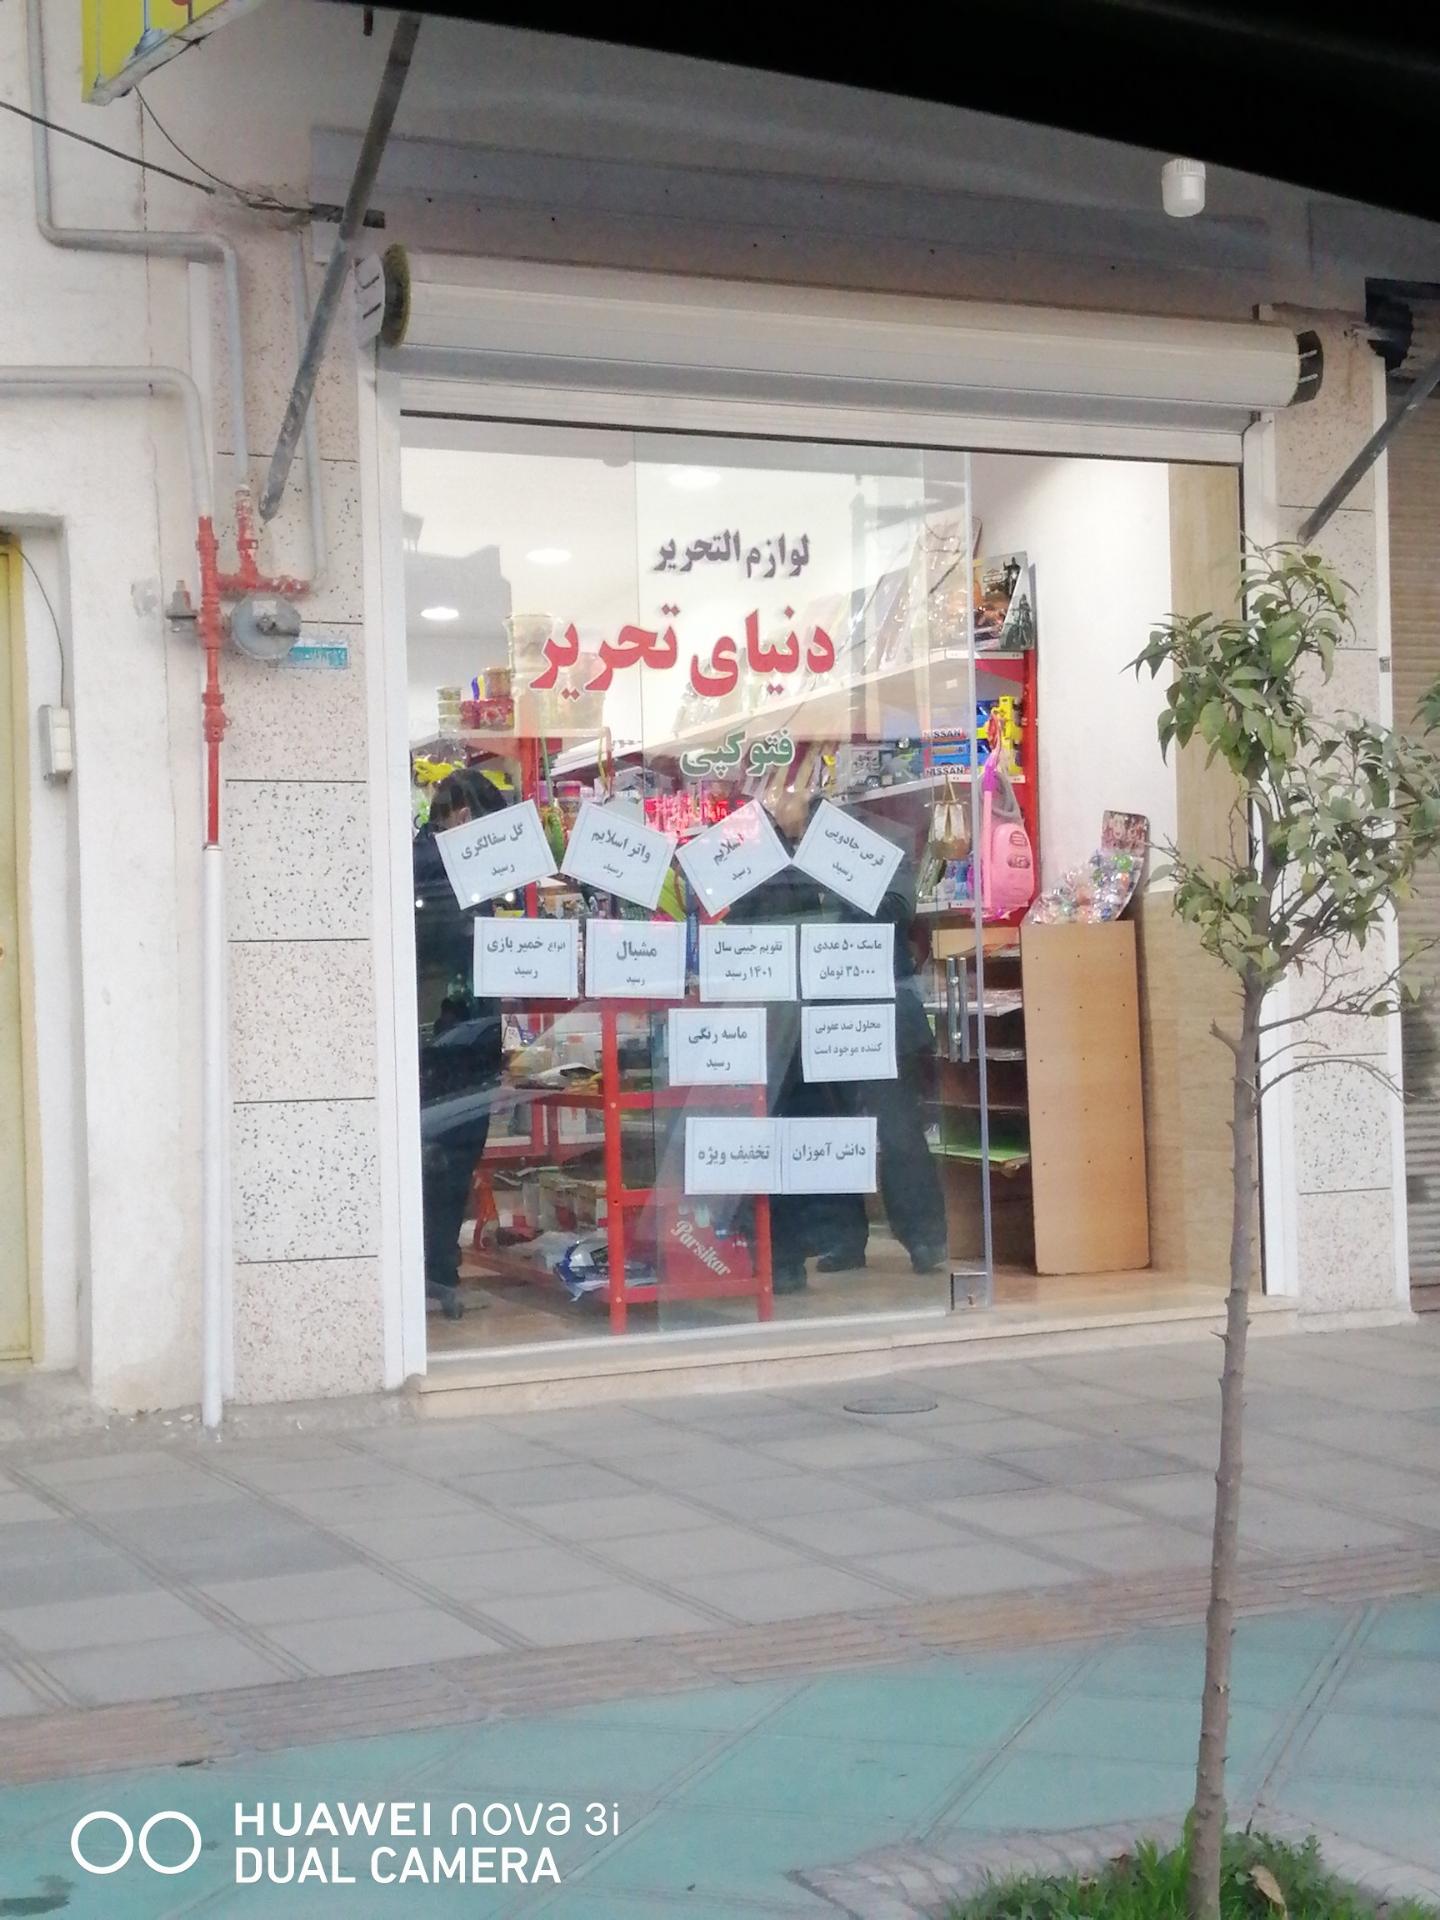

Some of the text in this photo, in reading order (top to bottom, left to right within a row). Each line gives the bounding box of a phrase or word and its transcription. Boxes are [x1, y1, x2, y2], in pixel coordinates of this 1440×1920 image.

[655, 529, 810, 578] لوازم التحریر
[529, 602, 836, 702] دنیای تحریر
[926, 765, 964, 777] NISSAN
[491, 863, 515, 877] رسید
[487, 936, 513, 953] بازی
[516, 936, 543, 953] خمیر
[616, 940, 657, 962] مشبال
[714, 941, 732, 955] سال
[759, 940, 783, 955] تقویم
[813, 938, 882, 954] ماسک ۵۰ عددی
[514, 966, 538, 979] رسید
[725, 970, 747, 981] رسید
[819, 965, 844, 980] تومان
[688, 1025, 748, 1045] ماسه رنگی
[706, 1059, 731, 1071] رسید
[698, 1144, 770, 1166] تخفیف ویژه
[792, 1142, 866, 1161] دانش آموزان
[670, 1220, 731, 1275] Parsikar
